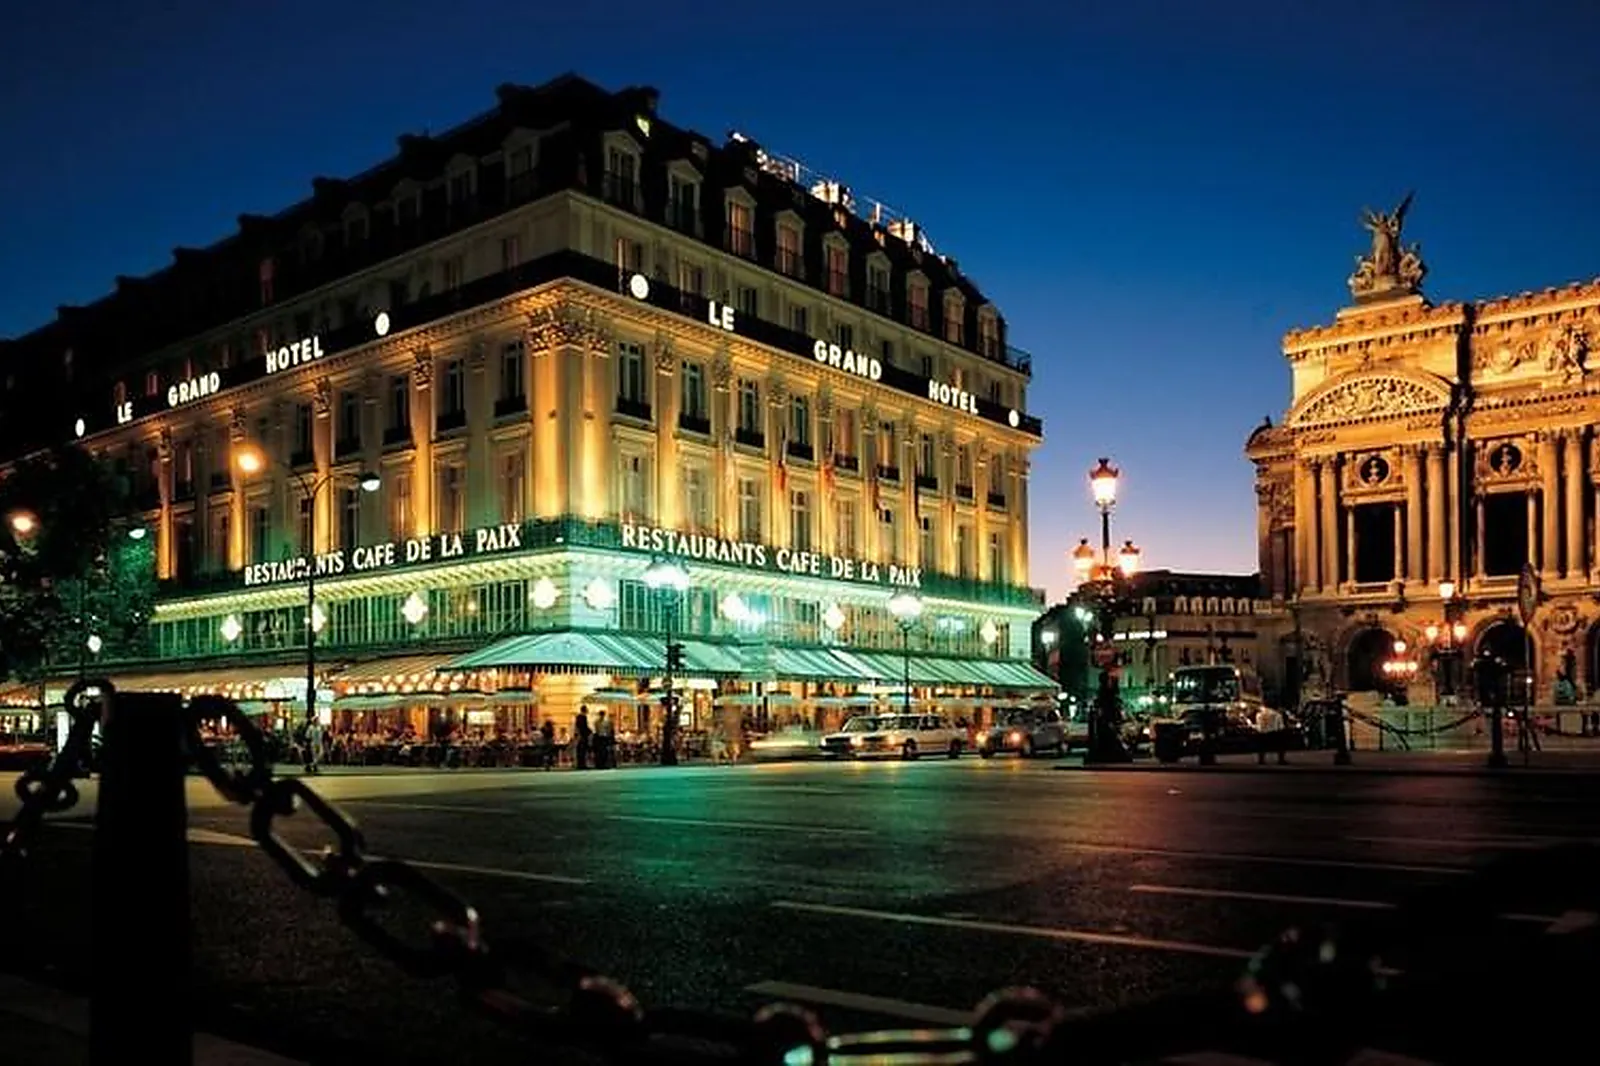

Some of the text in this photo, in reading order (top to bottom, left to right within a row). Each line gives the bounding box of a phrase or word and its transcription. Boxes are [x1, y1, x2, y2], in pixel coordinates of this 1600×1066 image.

[117, 335, 324, 424] LE GRAND HOTEL
[708, 300, 979, 415] LE GRAND HOTEL
[352, 542, 395, 570] CAFE
[406, 538, 432, 562] DE
[441, 534, 464, 558] LA
[476, 523, 521, 553] PAIX
[622, 524, 922, 588] RESTAURANTS CAFE DE LA PAIX
